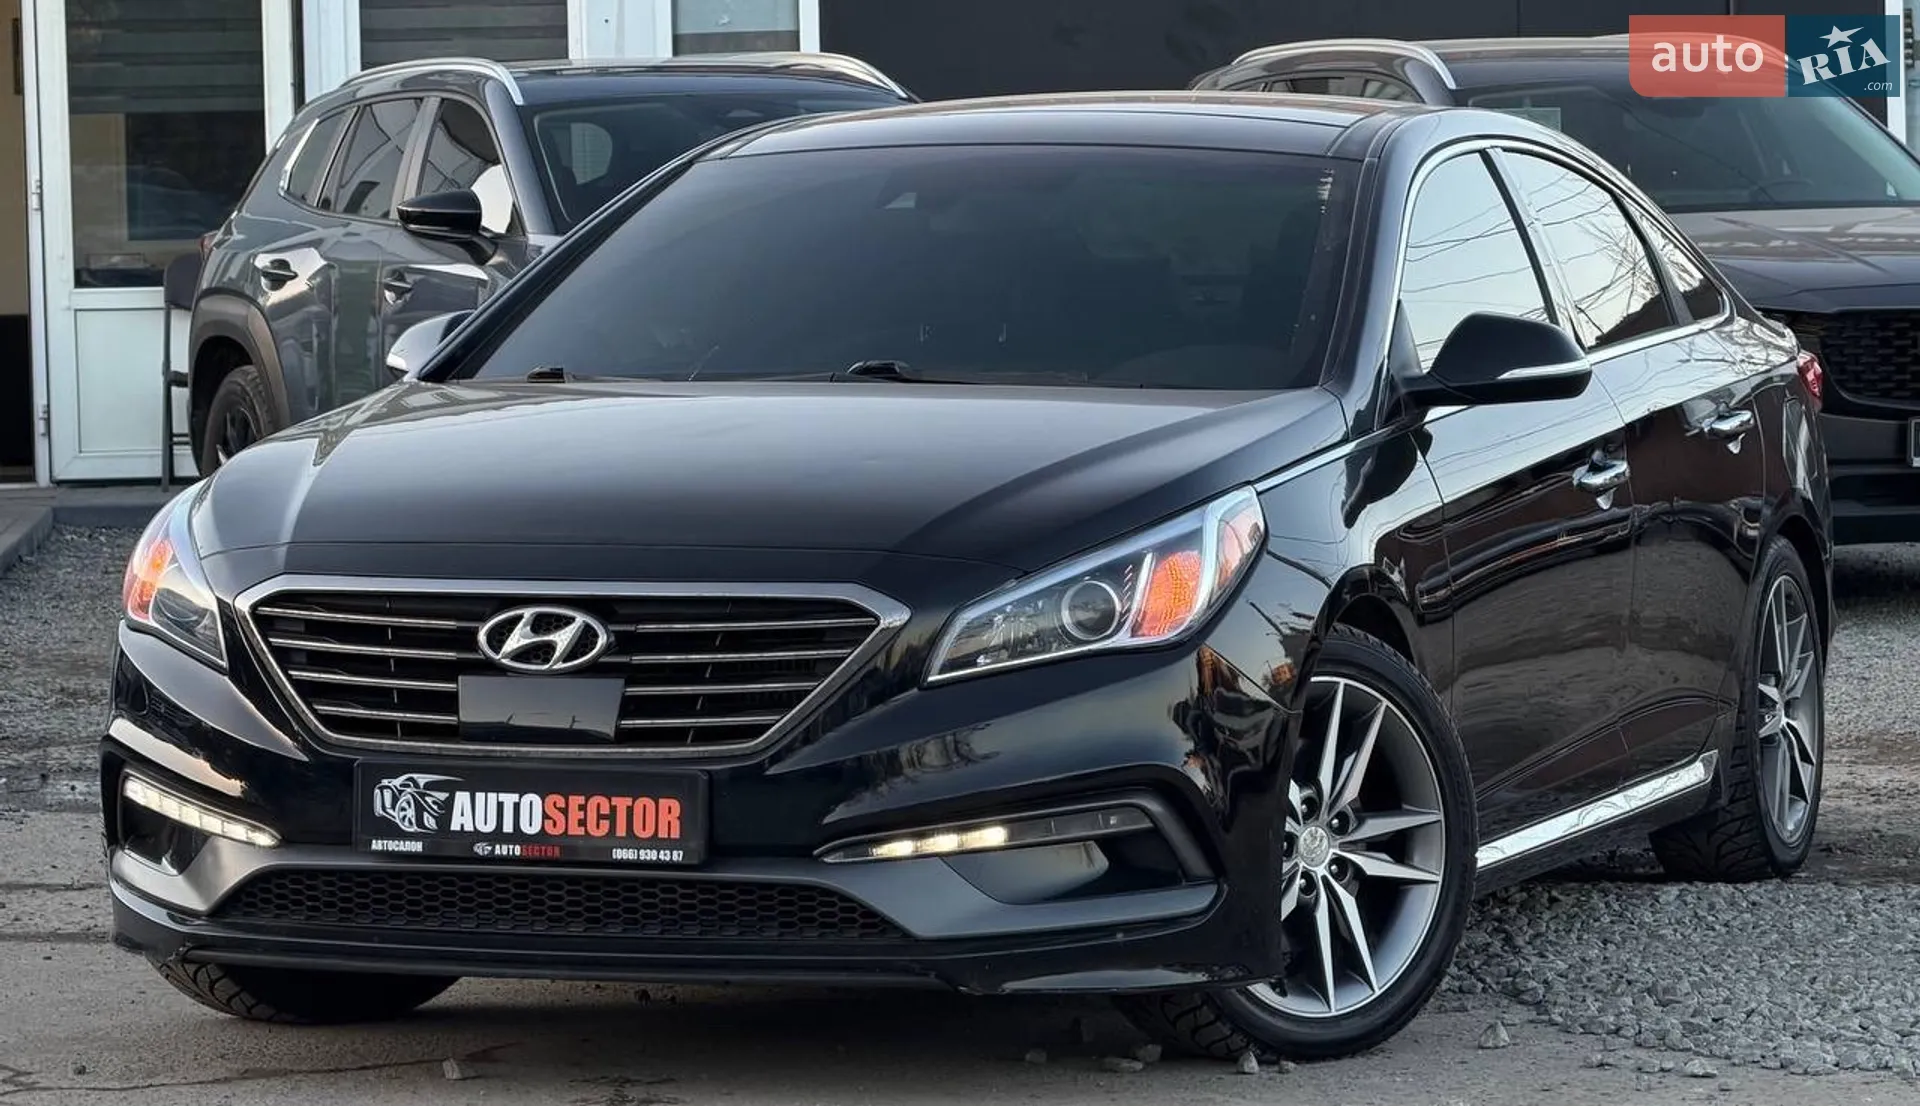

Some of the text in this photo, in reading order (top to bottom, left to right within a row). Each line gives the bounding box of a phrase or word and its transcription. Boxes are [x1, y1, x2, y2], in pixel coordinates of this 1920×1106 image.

[450, 791, 681, 839] AUTOSECTOR
[371, 839, 423, 853] АВТОСАЛОН
[639, 849, 657, 860] 930
[658, 850, 671, 861] 43
